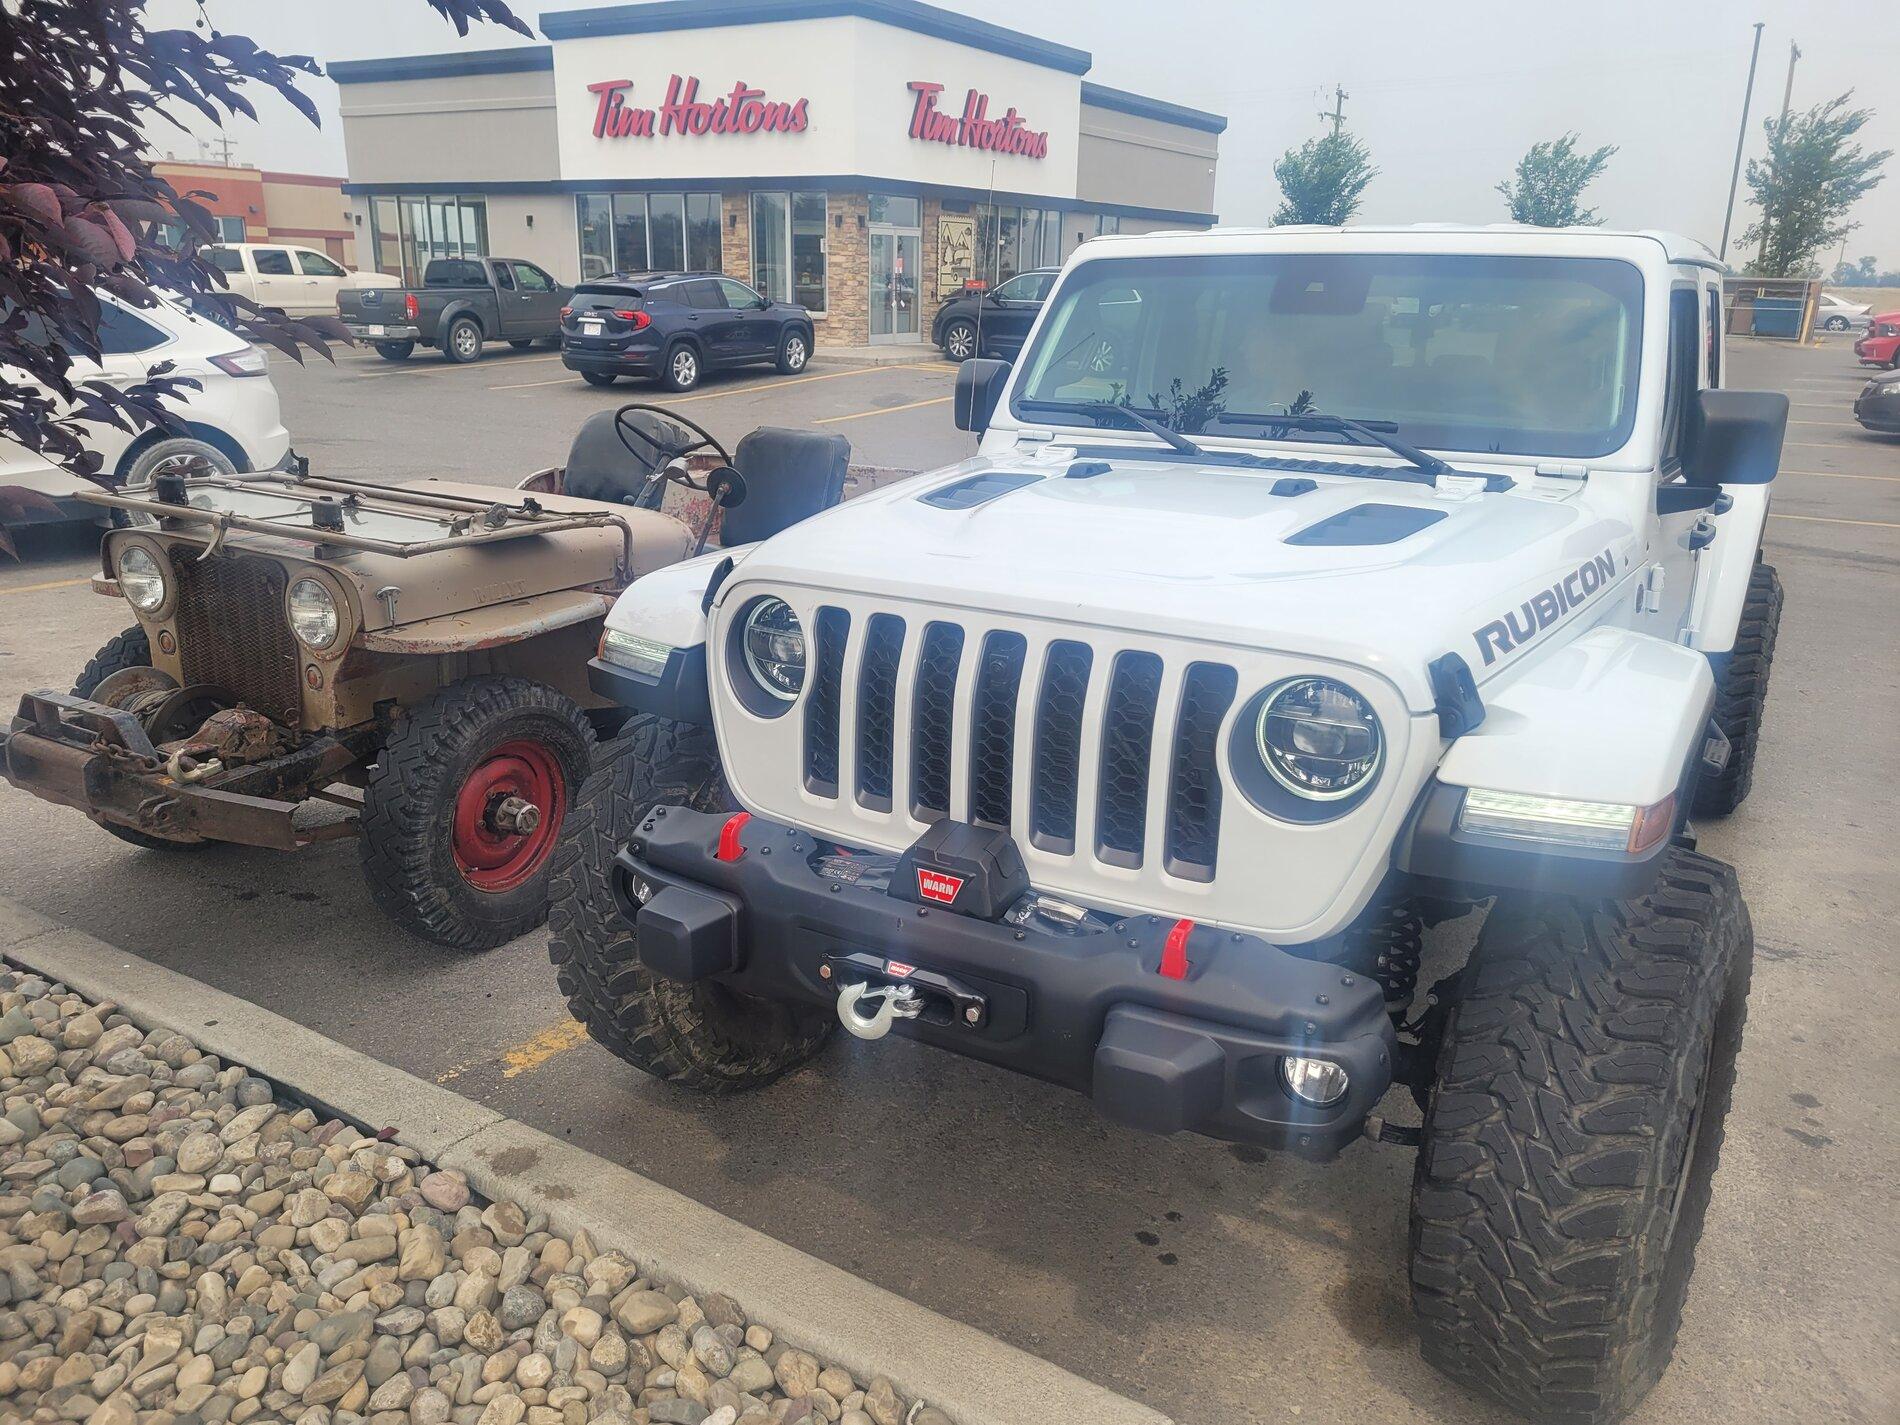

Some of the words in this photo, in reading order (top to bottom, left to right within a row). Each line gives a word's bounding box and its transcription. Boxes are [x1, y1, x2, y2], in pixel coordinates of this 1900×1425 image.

[586, 79, 655, 139] Tim
[659, 73, 809, 136] Hortons
[906, 81, 958, 145] Tim
[958, 88, 1049, 159] Hortons
[1472, 548, 1616, 667] RUBICON
[923, 878, 954, 896] WARN
